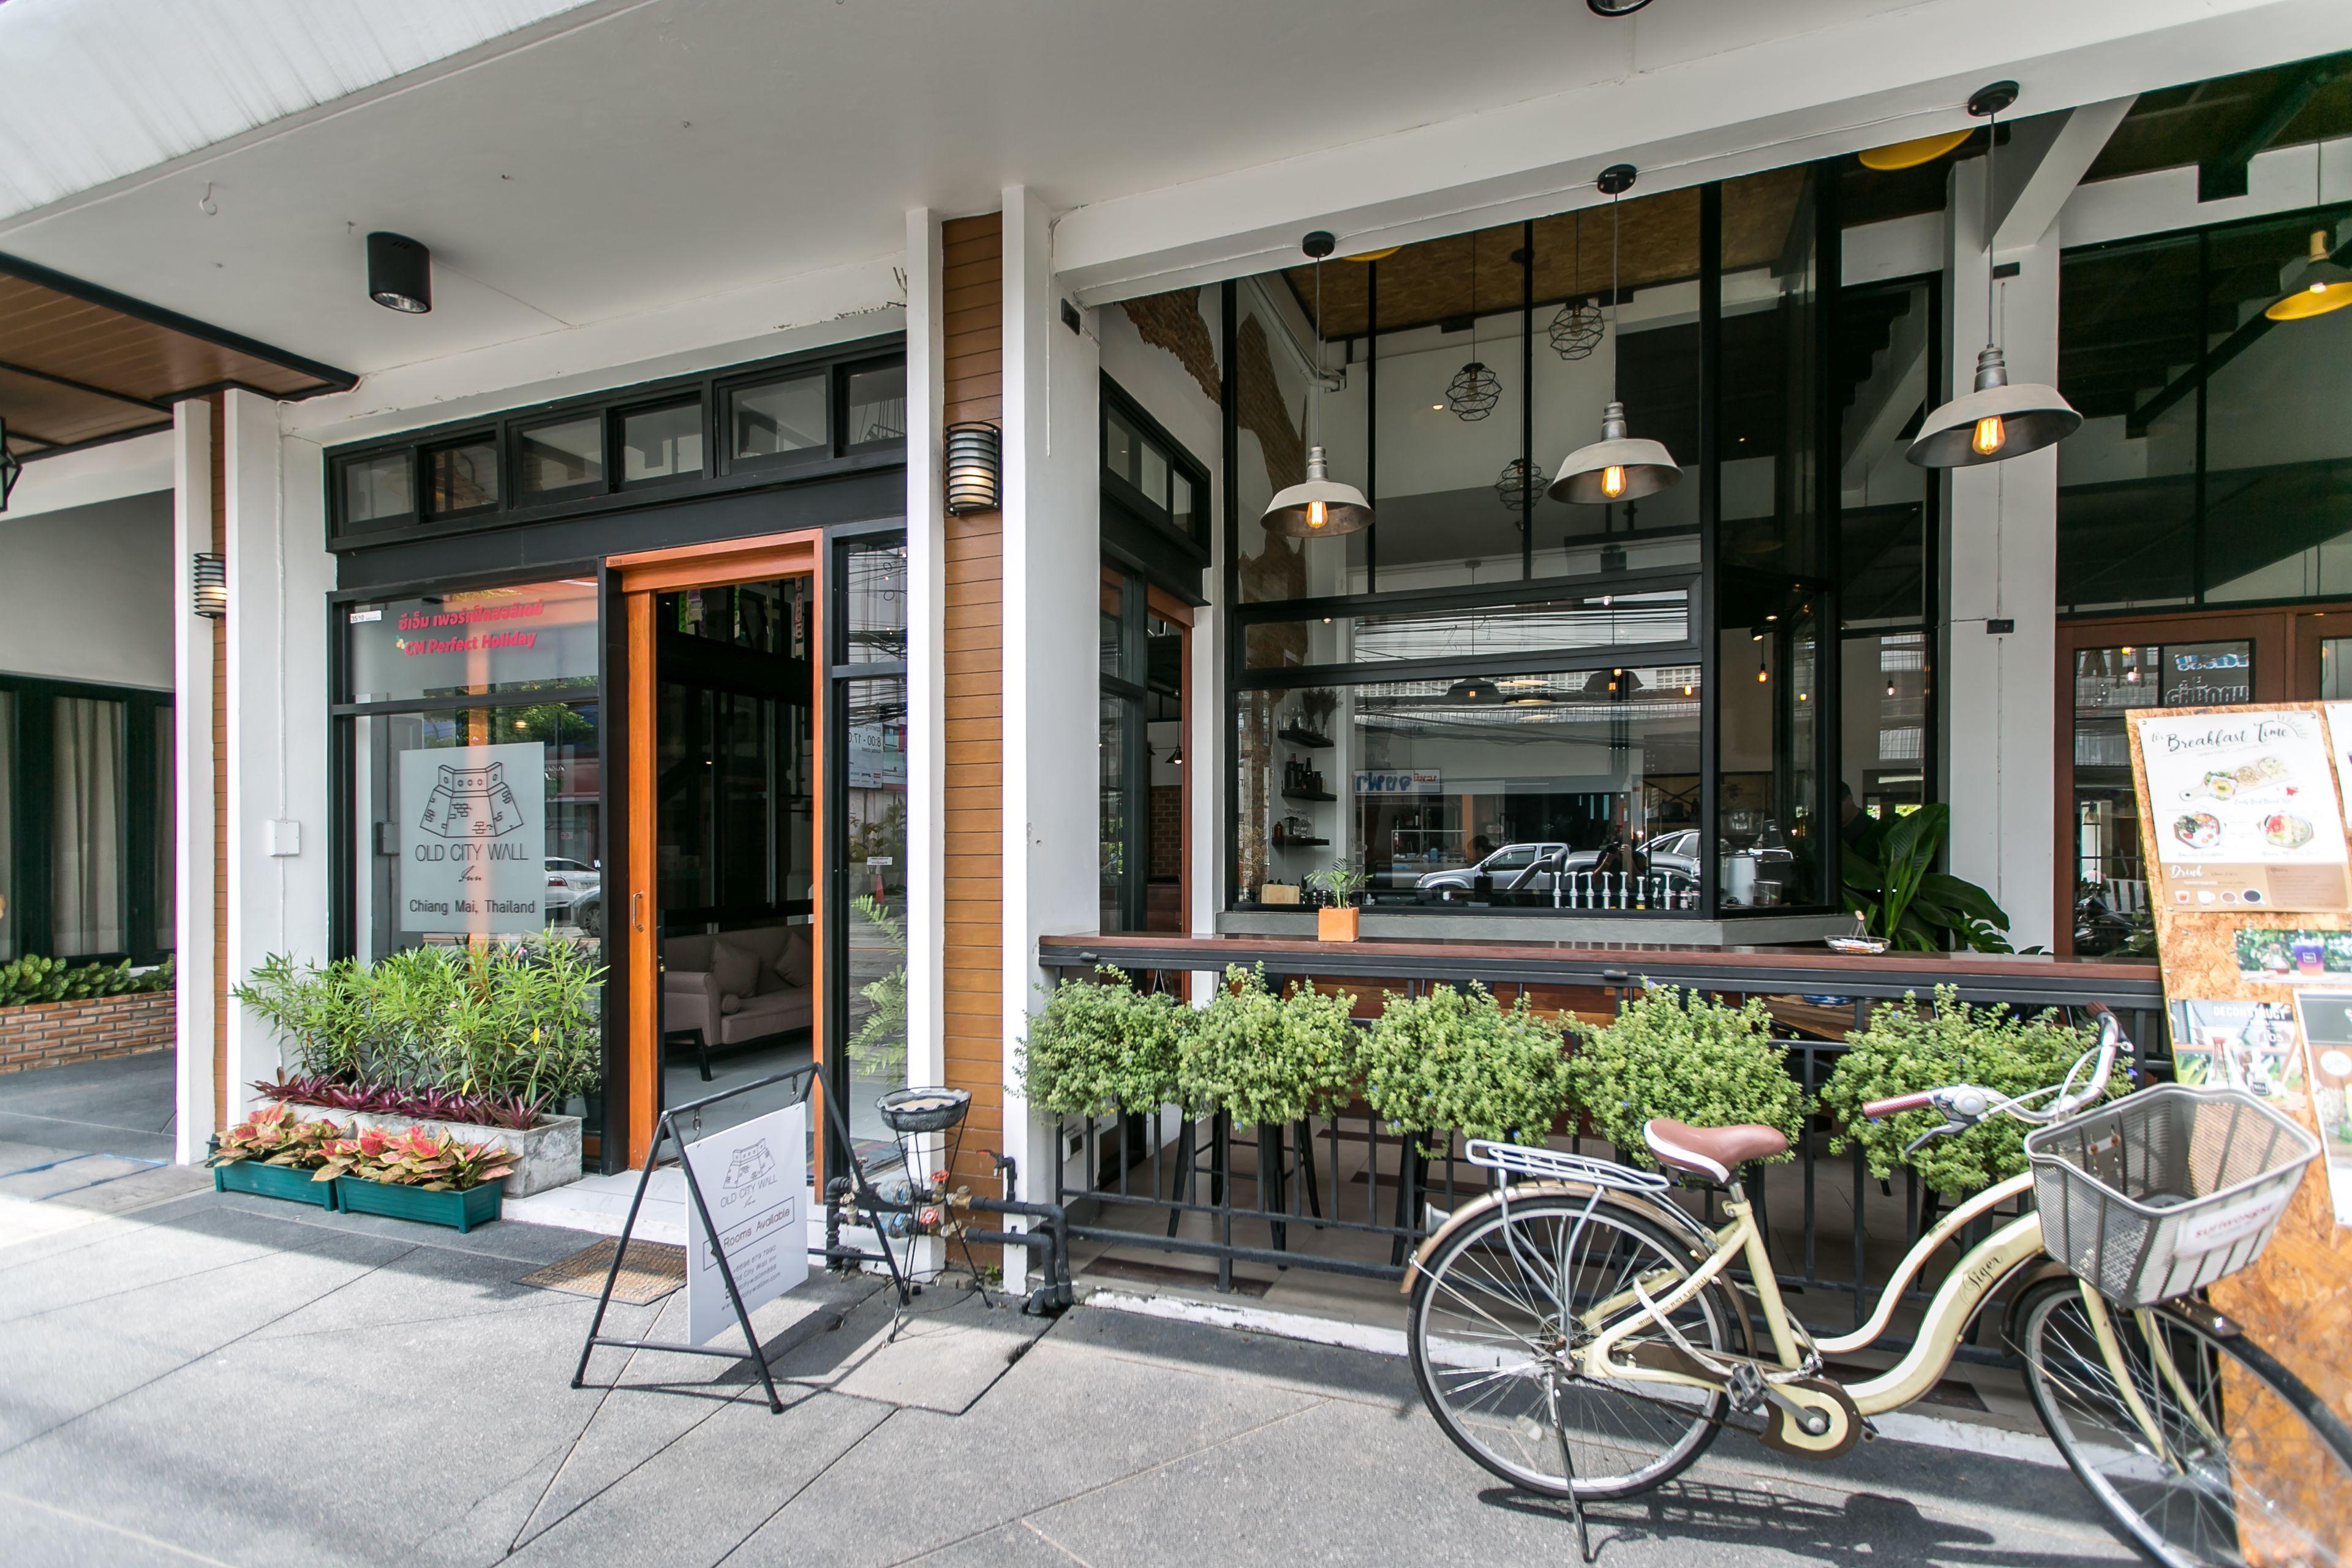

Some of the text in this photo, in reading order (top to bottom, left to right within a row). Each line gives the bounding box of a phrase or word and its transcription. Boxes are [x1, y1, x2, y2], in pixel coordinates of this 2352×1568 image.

[404, 632, 538, 656] CM Perfect Holiday
[2166, 729, 2247, 752] Breakfast
[2253, 720, 2288, 743] Time
[415, 843, 529, 861] OLD CITY WALL
[458, 865, 482, 882] Inn
[2169, 865, 2203, 878] Drink
[409, 899, 535, 915] Chiang Mai, Thailand
[720, 1174, 778, 1207] OLD CITY WALL
[723, 1208, 790, 1249] Rooms Available
